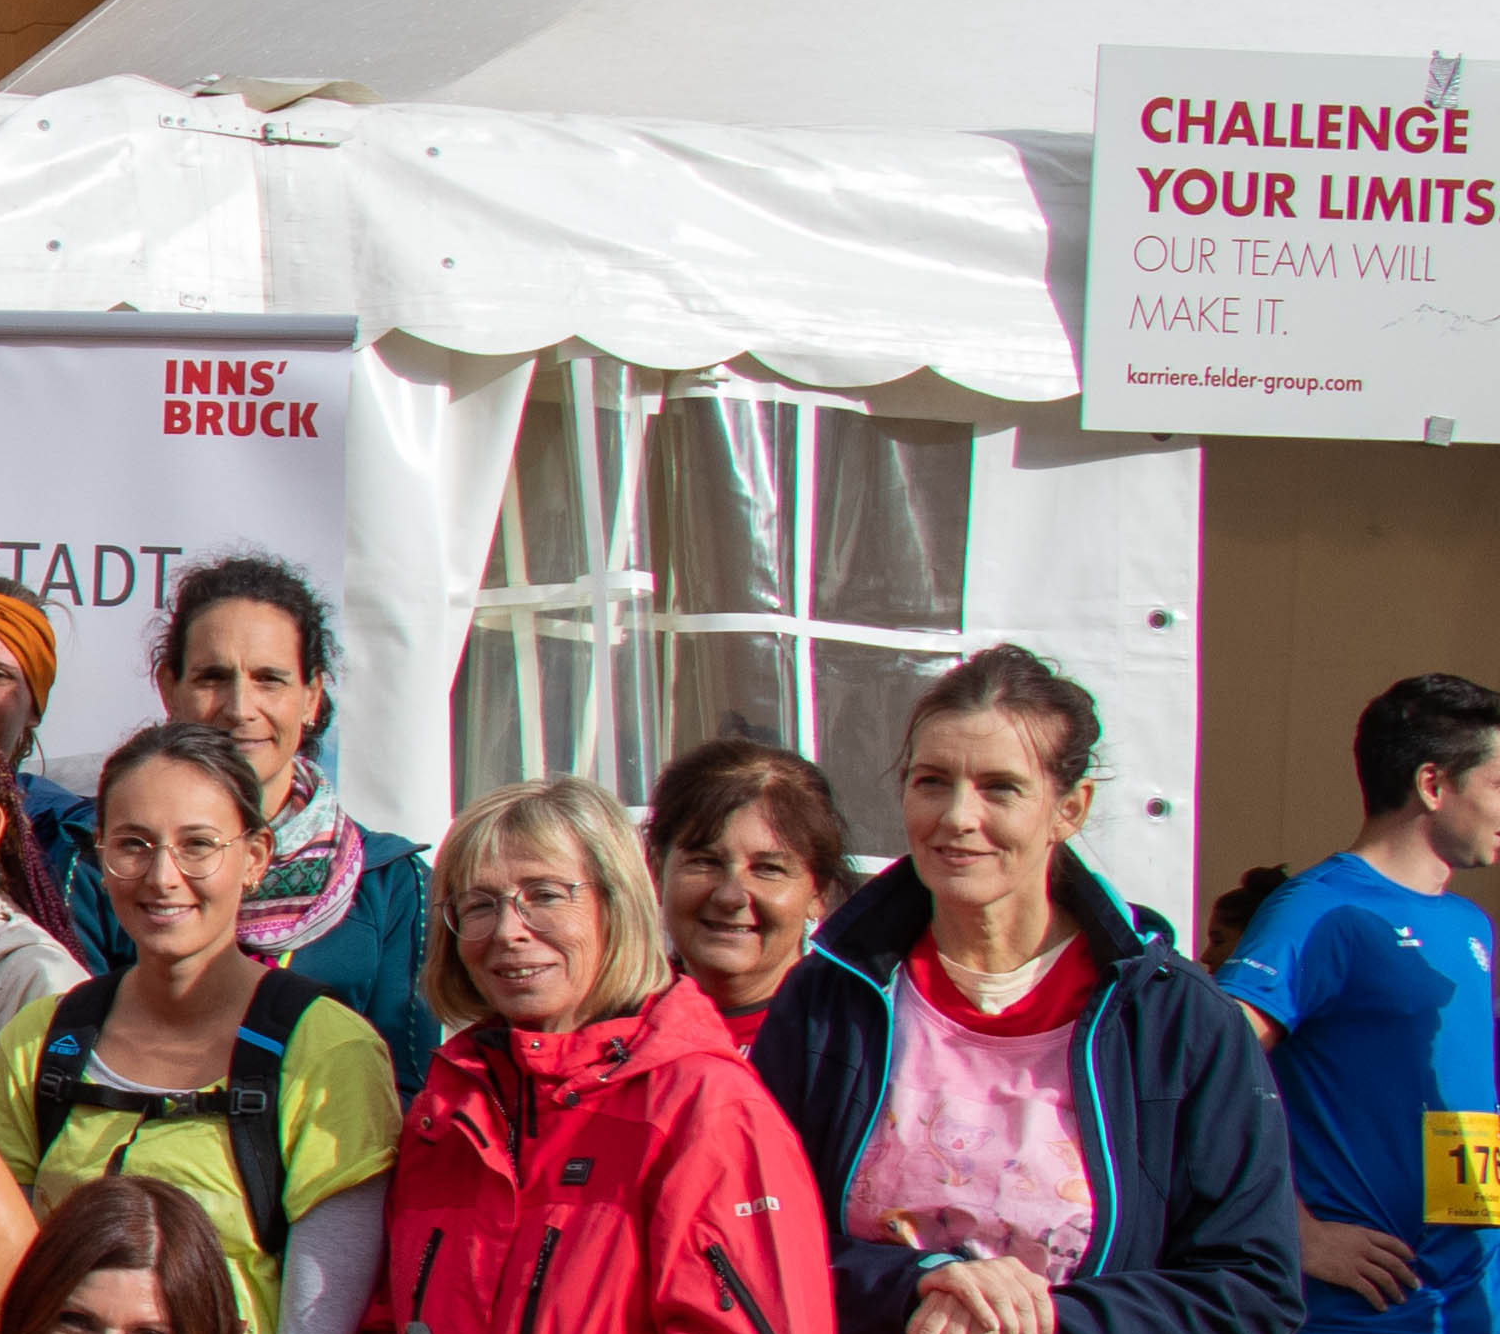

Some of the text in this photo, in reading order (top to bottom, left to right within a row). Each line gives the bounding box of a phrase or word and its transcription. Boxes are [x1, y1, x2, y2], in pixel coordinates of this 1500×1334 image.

[1140, 96, 1470, 155] CHALLENGE
[1136, 167, 1298, 219] YOUR
[1133, 235, 1437, 282] OUR TEAM WILL
[1129, 294, 1289, 336] MAKE IT.
[164, 359, 288, 396] INNS'
[1126, 363, 1363, 396] karriere.felder-group.com
[163, 400, 319, 439] BRUCK
